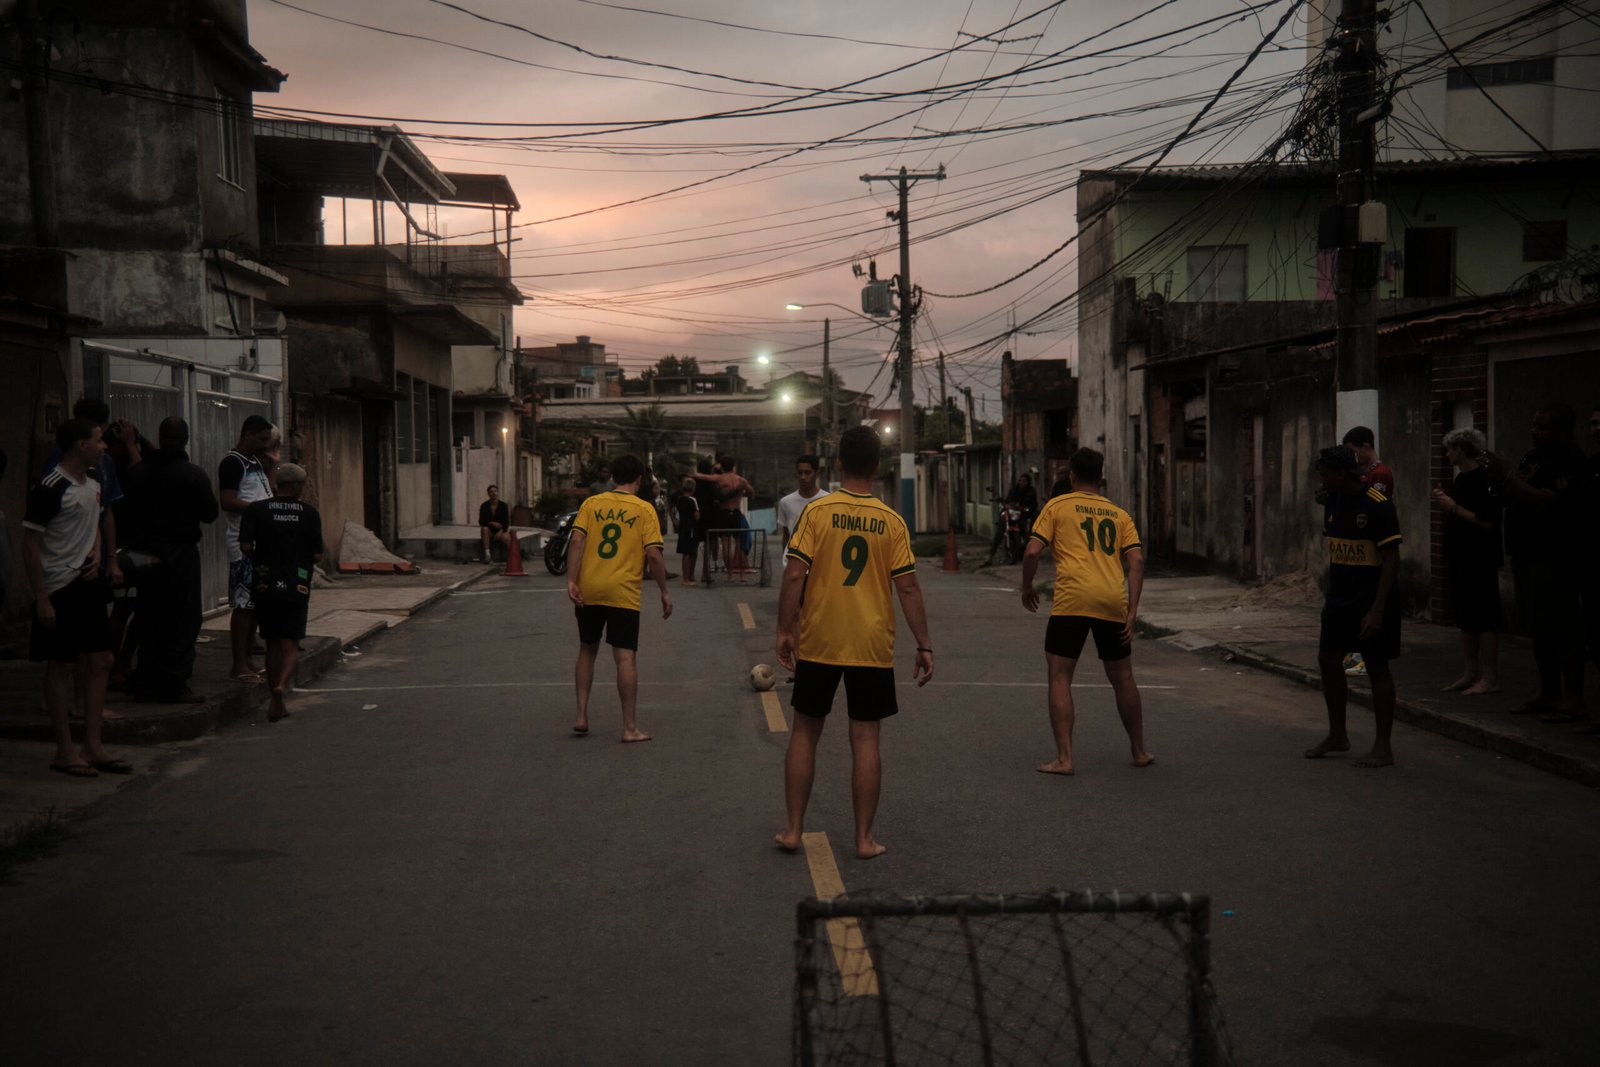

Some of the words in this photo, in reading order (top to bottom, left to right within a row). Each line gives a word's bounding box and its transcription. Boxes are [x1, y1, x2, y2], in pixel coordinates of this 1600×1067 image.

[268, 502, 304, 512] DIRETORIA
[1075, 504, 1118, 519] RONALDINHO
[594, 508, 640, 529] KAKÁ
[832, 513, 885, 535] RONALDO
[598, 523, 622, 559] 8
[1080, 516, 1116, 556] 10
[842, 535, 868, 586] 9
